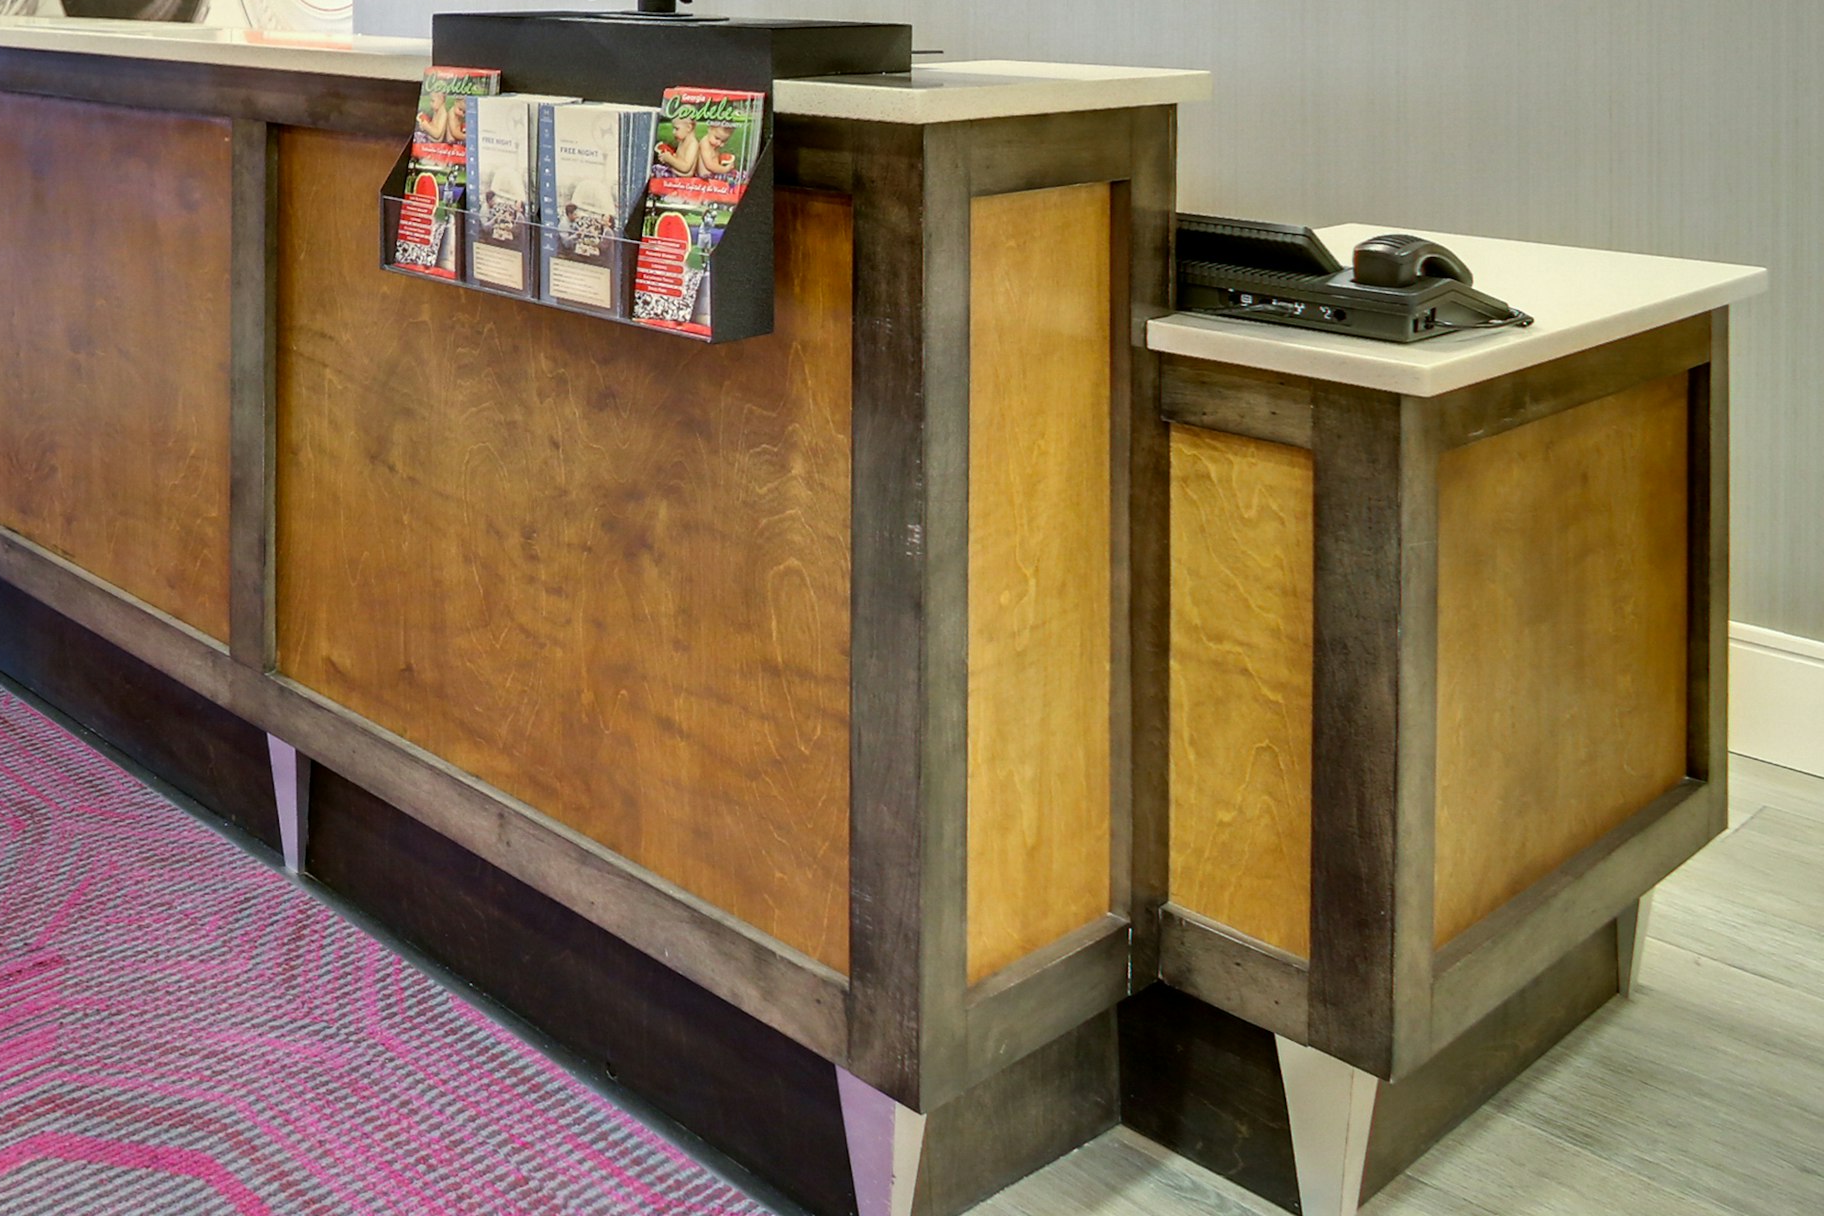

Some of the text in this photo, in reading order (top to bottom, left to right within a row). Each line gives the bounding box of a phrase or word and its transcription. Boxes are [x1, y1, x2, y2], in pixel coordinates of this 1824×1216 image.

[681, 93, 706, 103] Georgia
[665, 95, 734, 120] Cordele
[560, 146, 599, 157] FREE NIGHT
